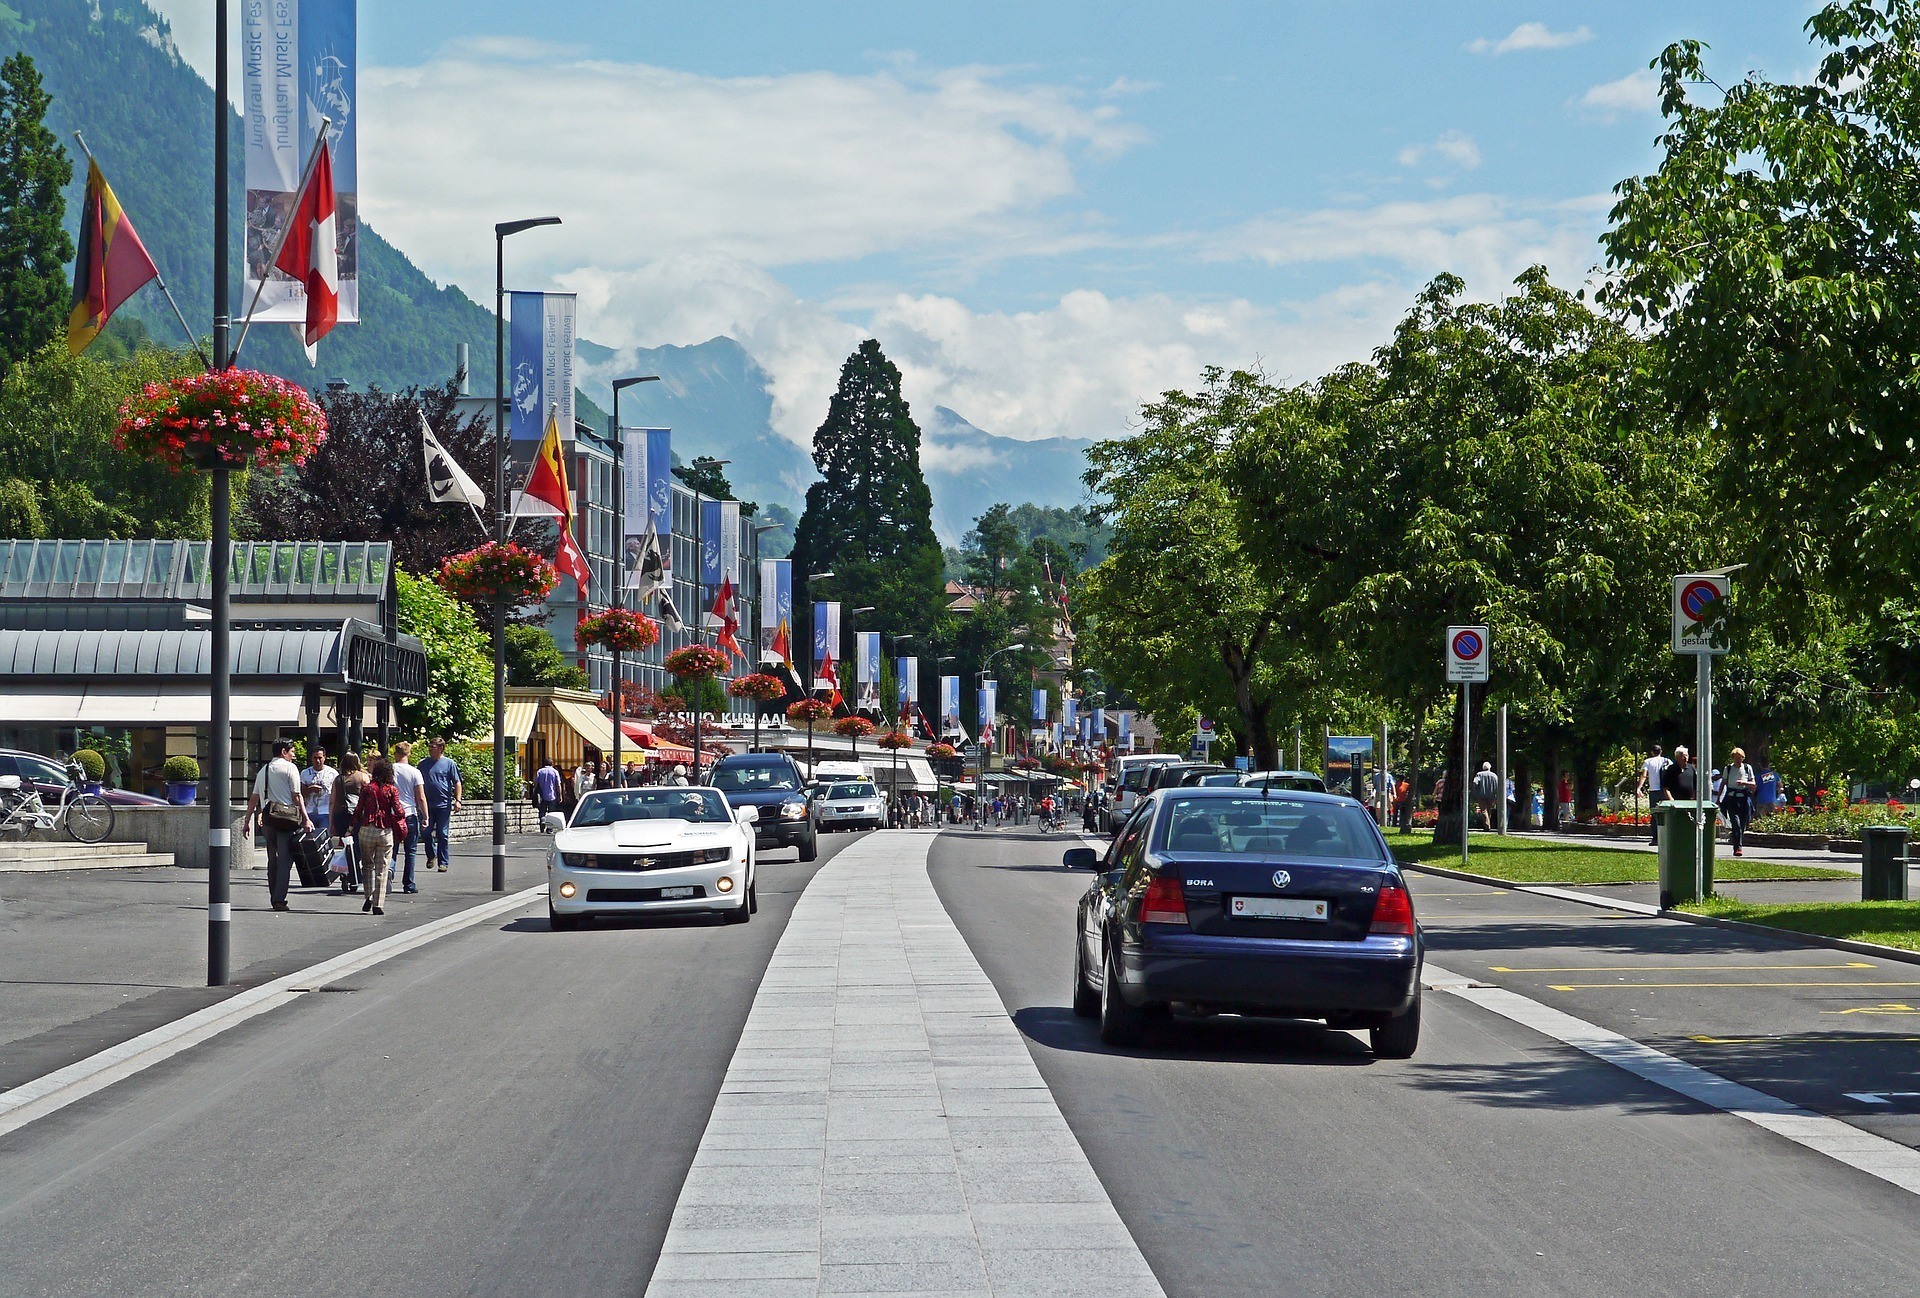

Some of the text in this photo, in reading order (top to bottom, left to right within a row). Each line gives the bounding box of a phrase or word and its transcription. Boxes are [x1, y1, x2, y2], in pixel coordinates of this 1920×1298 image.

[246, 0, 267, 150] Jungfrau Music Fes
[546, 314, 556, 348] Festival
[546, 350, 556, 377] Music
[1186, 878, 1214, 887] BORA
